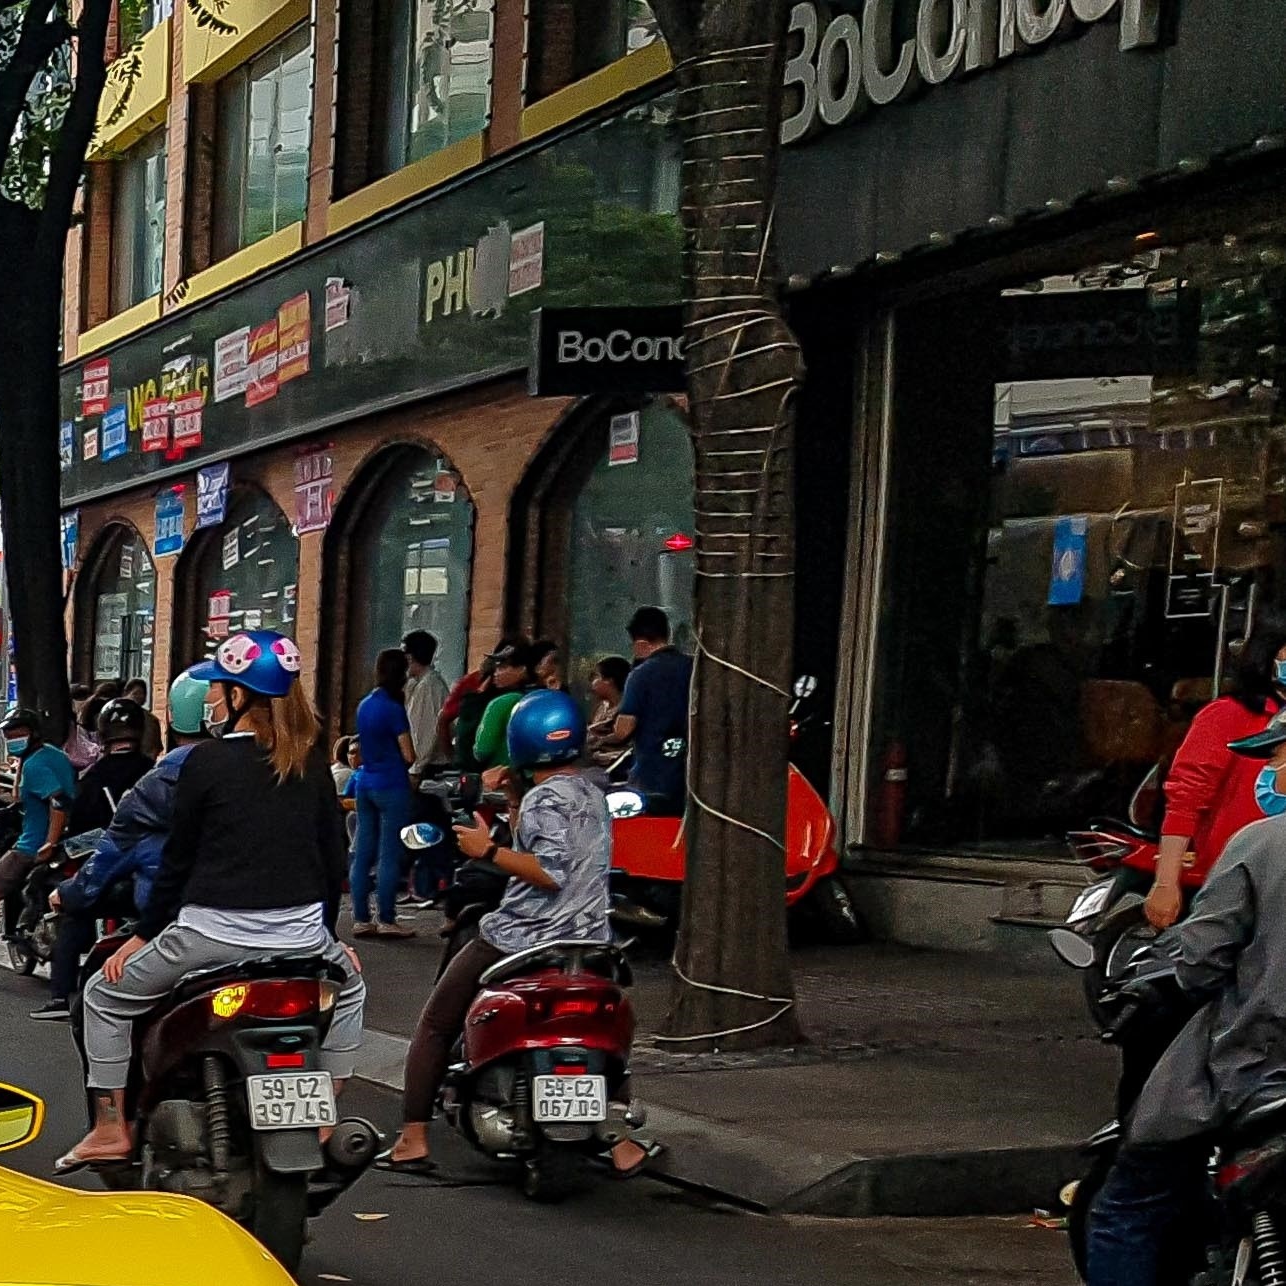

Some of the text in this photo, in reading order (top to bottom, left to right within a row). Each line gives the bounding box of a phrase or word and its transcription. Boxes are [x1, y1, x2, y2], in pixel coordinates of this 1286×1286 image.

[781, 0, 1158, 145] BoCon
[558, 329, 686, 363] BoConc
[262, 1077, 321, 1100] 59-C2
